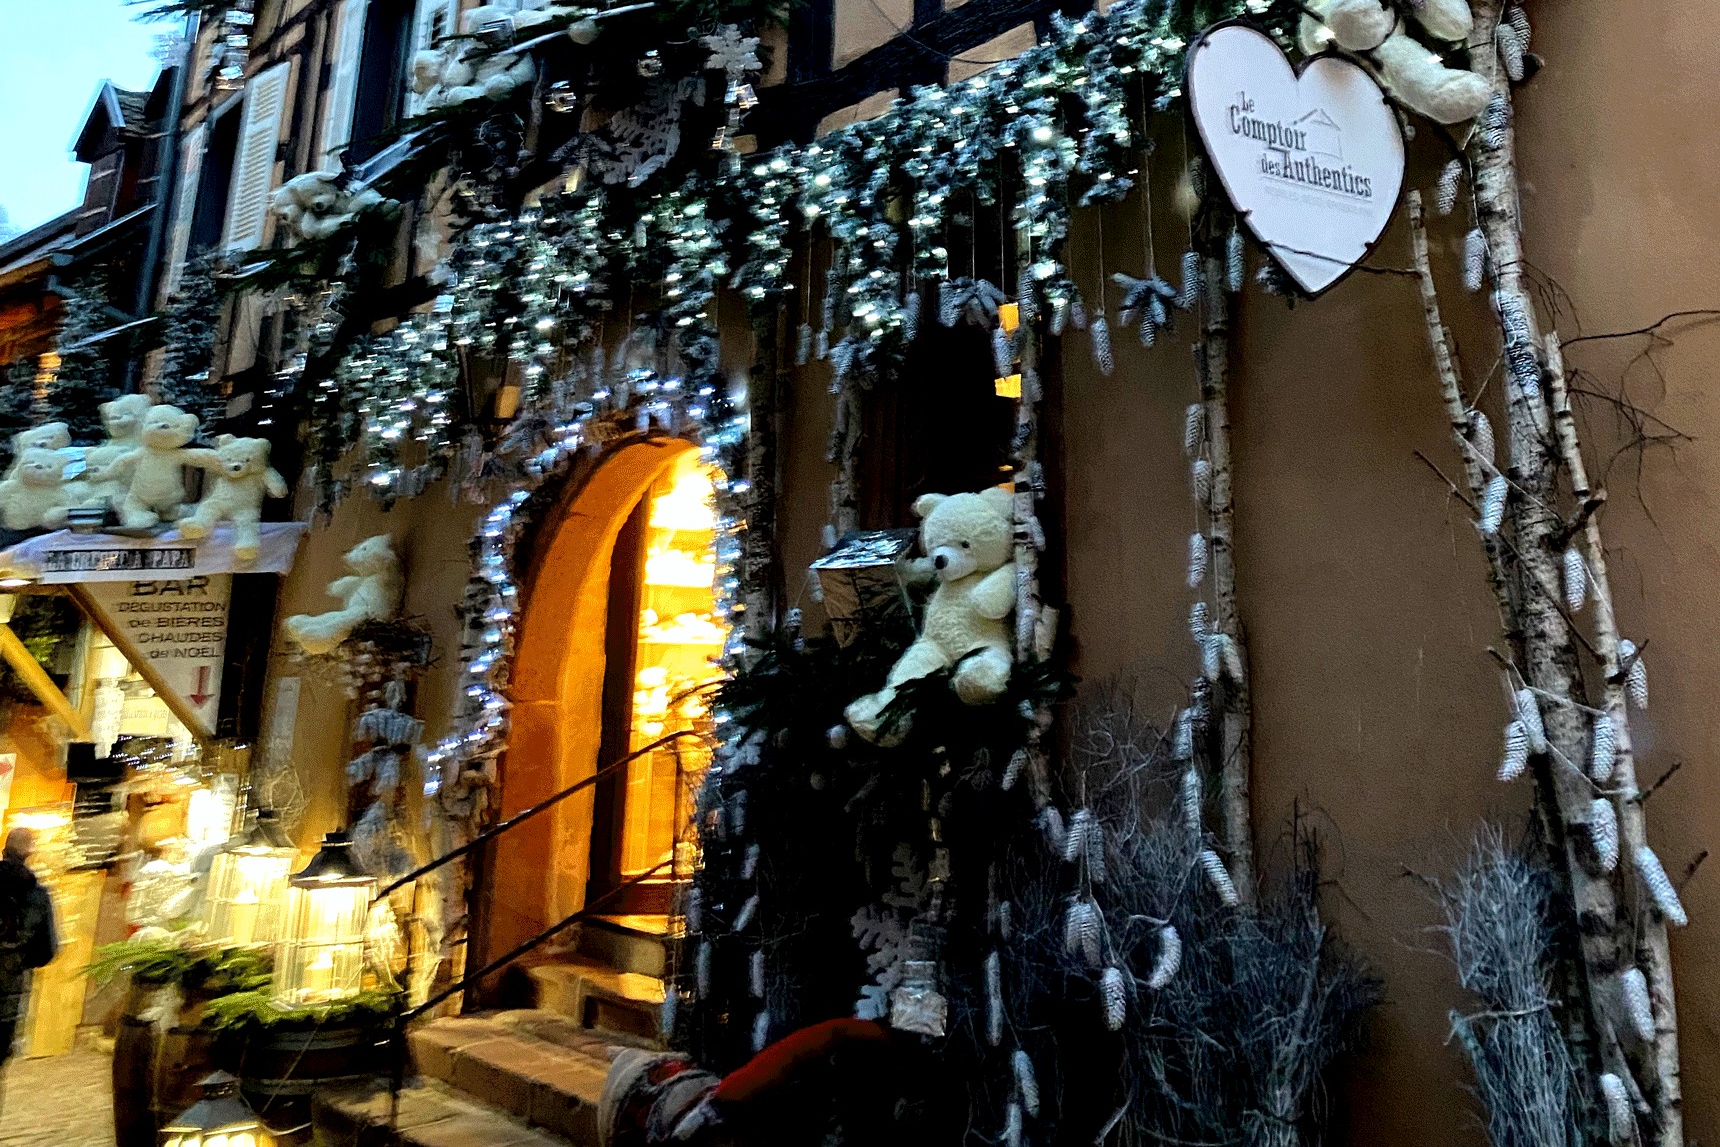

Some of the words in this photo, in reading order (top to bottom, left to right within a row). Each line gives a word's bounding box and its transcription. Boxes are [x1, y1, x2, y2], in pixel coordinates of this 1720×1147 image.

[1241, 90, 1255, 113] Le
[1230, 104, 1307, 151] Comptoir
[1261, 153, 1280, 176] des
[1281, 150, 1373, 198] Authentics
[152, 550, 190, 568] PAPA
[130, 575, 210, 596] BAR
[139, 632, 224, 643] CHAUDES
